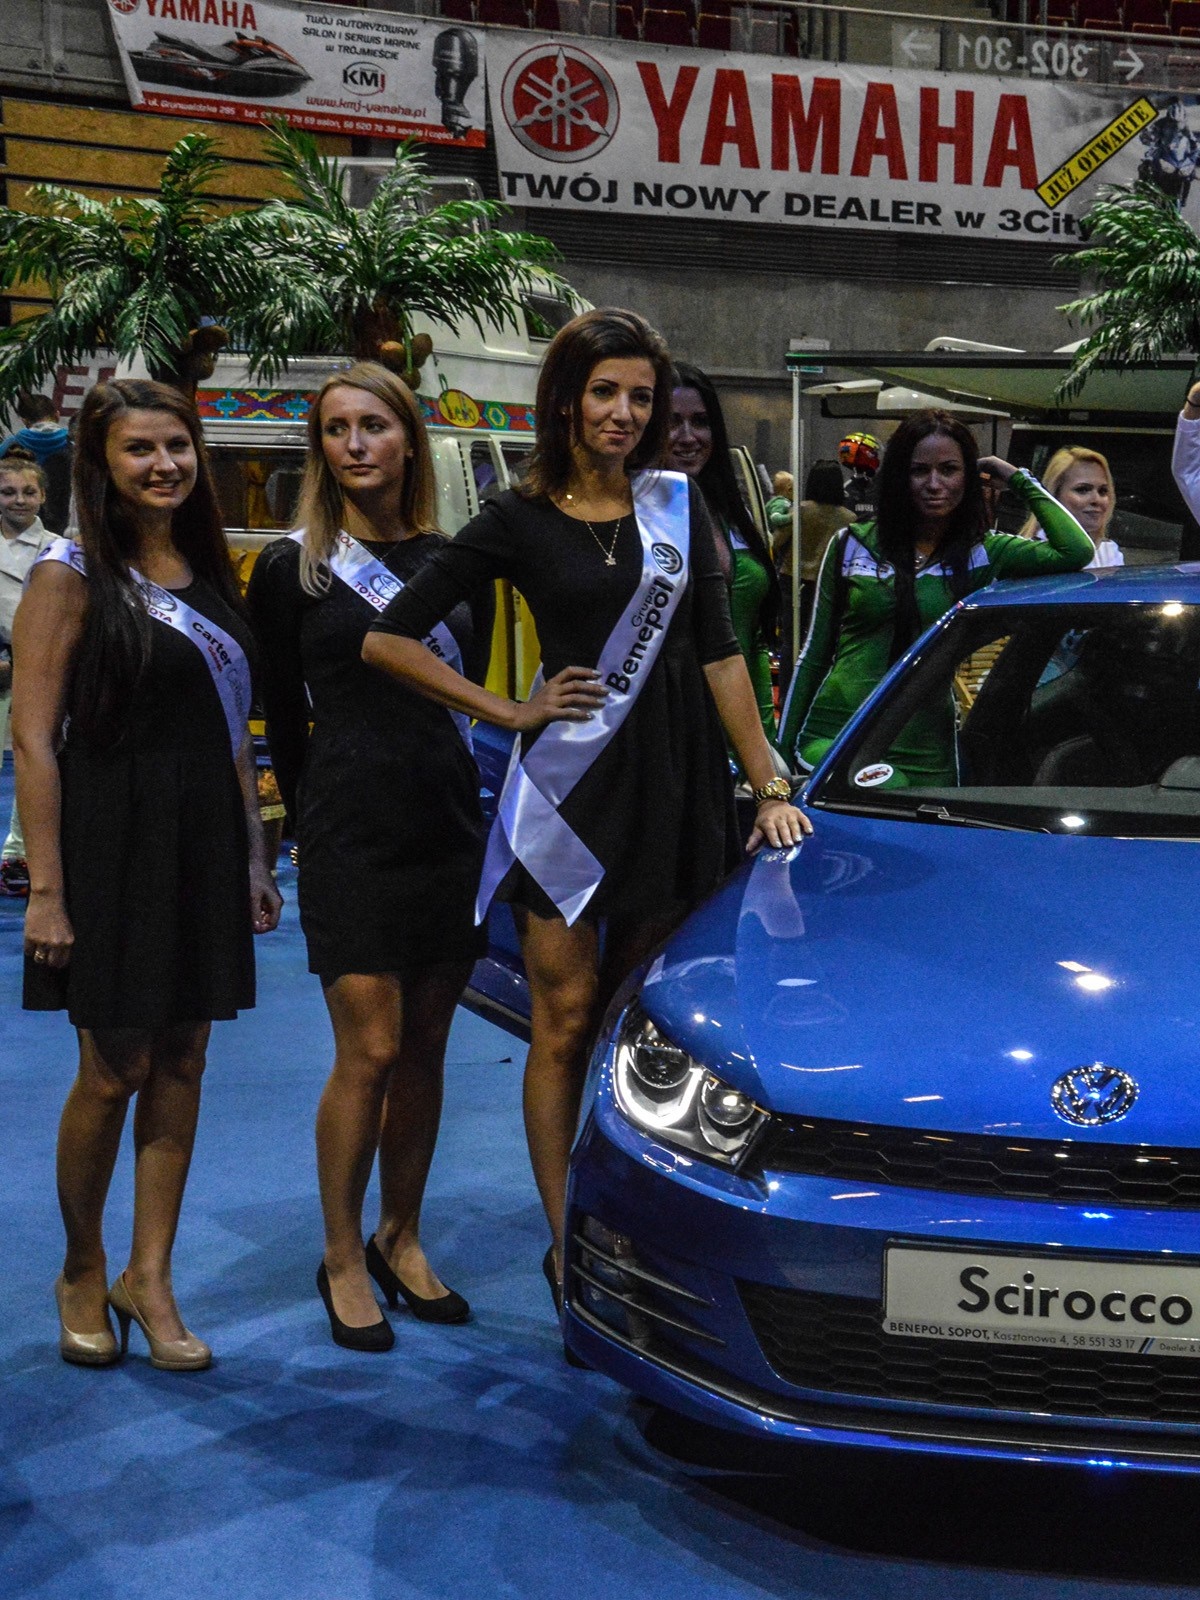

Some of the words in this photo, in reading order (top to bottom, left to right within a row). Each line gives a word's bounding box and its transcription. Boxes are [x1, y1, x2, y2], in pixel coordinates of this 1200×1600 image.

[145, 0, 258, 31] YAMAHA
[305, 14, 334, 26] TWÓJ
[336, 18, 419, 36] AUTORYZOWANY
[302, 27, 337, 40] SALON
[344, 32, 382, 45] SERWIS
[383, 37, 422, 51] MARINE
[305, 95, 427, 118] www.kmj-yamaha.pl
[635, 60, 1040, 191] YAMAHA
[1045, 163, 1079, 204] JUŻ
[1078, 103, 1150, 175] OTWARTE
[500, 169, 619, 206] TWÓJ
[632, 181, 771, 215] NOWY
[783, 192, 942, 228] DEALER
[354, 581, 388, 611] TOYOT
[192, 621, 232, 667] Carter
[605, 578, 675, 694] Benepol
[957, 1264, 1194, 1326] Scirocco
[889, 1322, 945, 1336] BENEPOL
[947, 1327, 991, 1341] SOPOT,
[993, 1332, 1058, 1345] Kasztanowa
[1059, 1335, 1070, 1347] 4,
[1072, 1335, 1086, 1346] 58
[1088, 1336, 1106, 1347] 551
[1108, 1337, 1123, 1348] 33
[1125, 1338, 1136, 1349] 17
[1159, 1342, 1188, 1352] Dealer
